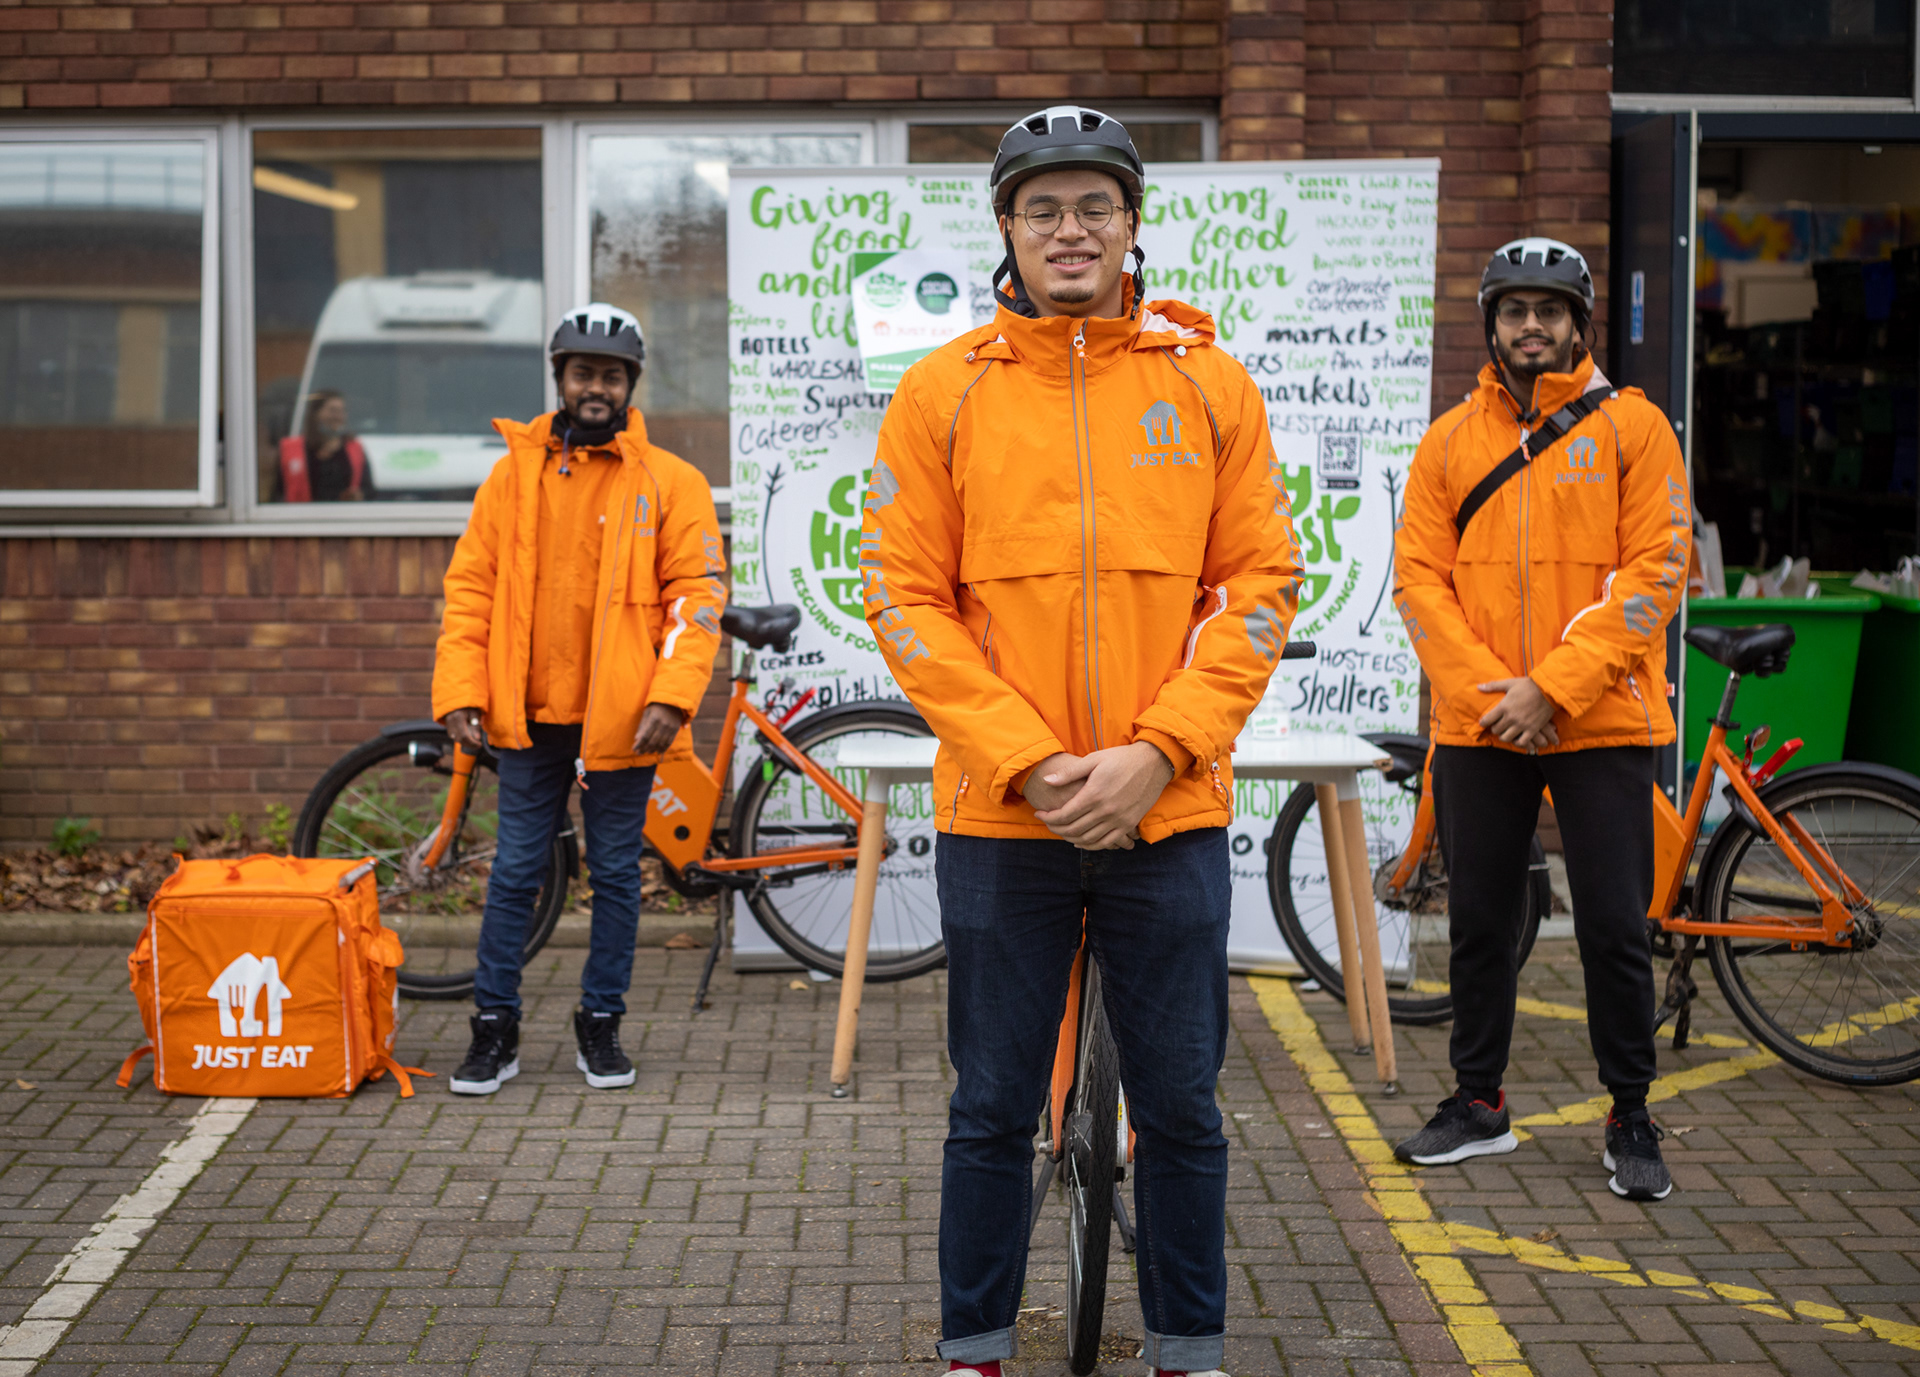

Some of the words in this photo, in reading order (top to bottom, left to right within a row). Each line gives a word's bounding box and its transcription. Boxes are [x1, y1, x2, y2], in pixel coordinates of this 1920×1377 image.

[750, 185, 899, 230] Giving
[1141, 184, 1275, 227] Giving
[811, 212, 923, 270] food
[1191, 207, 1298, 265] food
[1144, 249, 1296, 293] another
[740, 337, 810, 355] HOTELS
[1266, 319, 1388, 346] markets
[738, 418, 838, 455] Caterers
[1130, 452, 1169, 468] JUST
[1172, 451, 1201, 465] EAT
[1554, 472, 1584, 485] JUST
[1585, 472, 1608, 484] EAT
[1666, 475, 1691, 530] EAT
[1655, 531, 1688, 600] JUST
[790, 567, 842, 637] RESCUING
[844, 633, 881, 654] FOO
[859, 527, 893, 606] JUST
[877, 605, 931, 665] EAT
[1295, 618, 1325, 642] THE
[1323, 556, 1363, 623] HUNGRY
[1399, 600, 1429, 643] EAT
[1319, 648, 1409, 675] HOSTELS
[1290, 669, 1389, 715] Shelters
[191, 1044, 257, 1070] JUST
[260, 1045, 314, 1068] EAT
